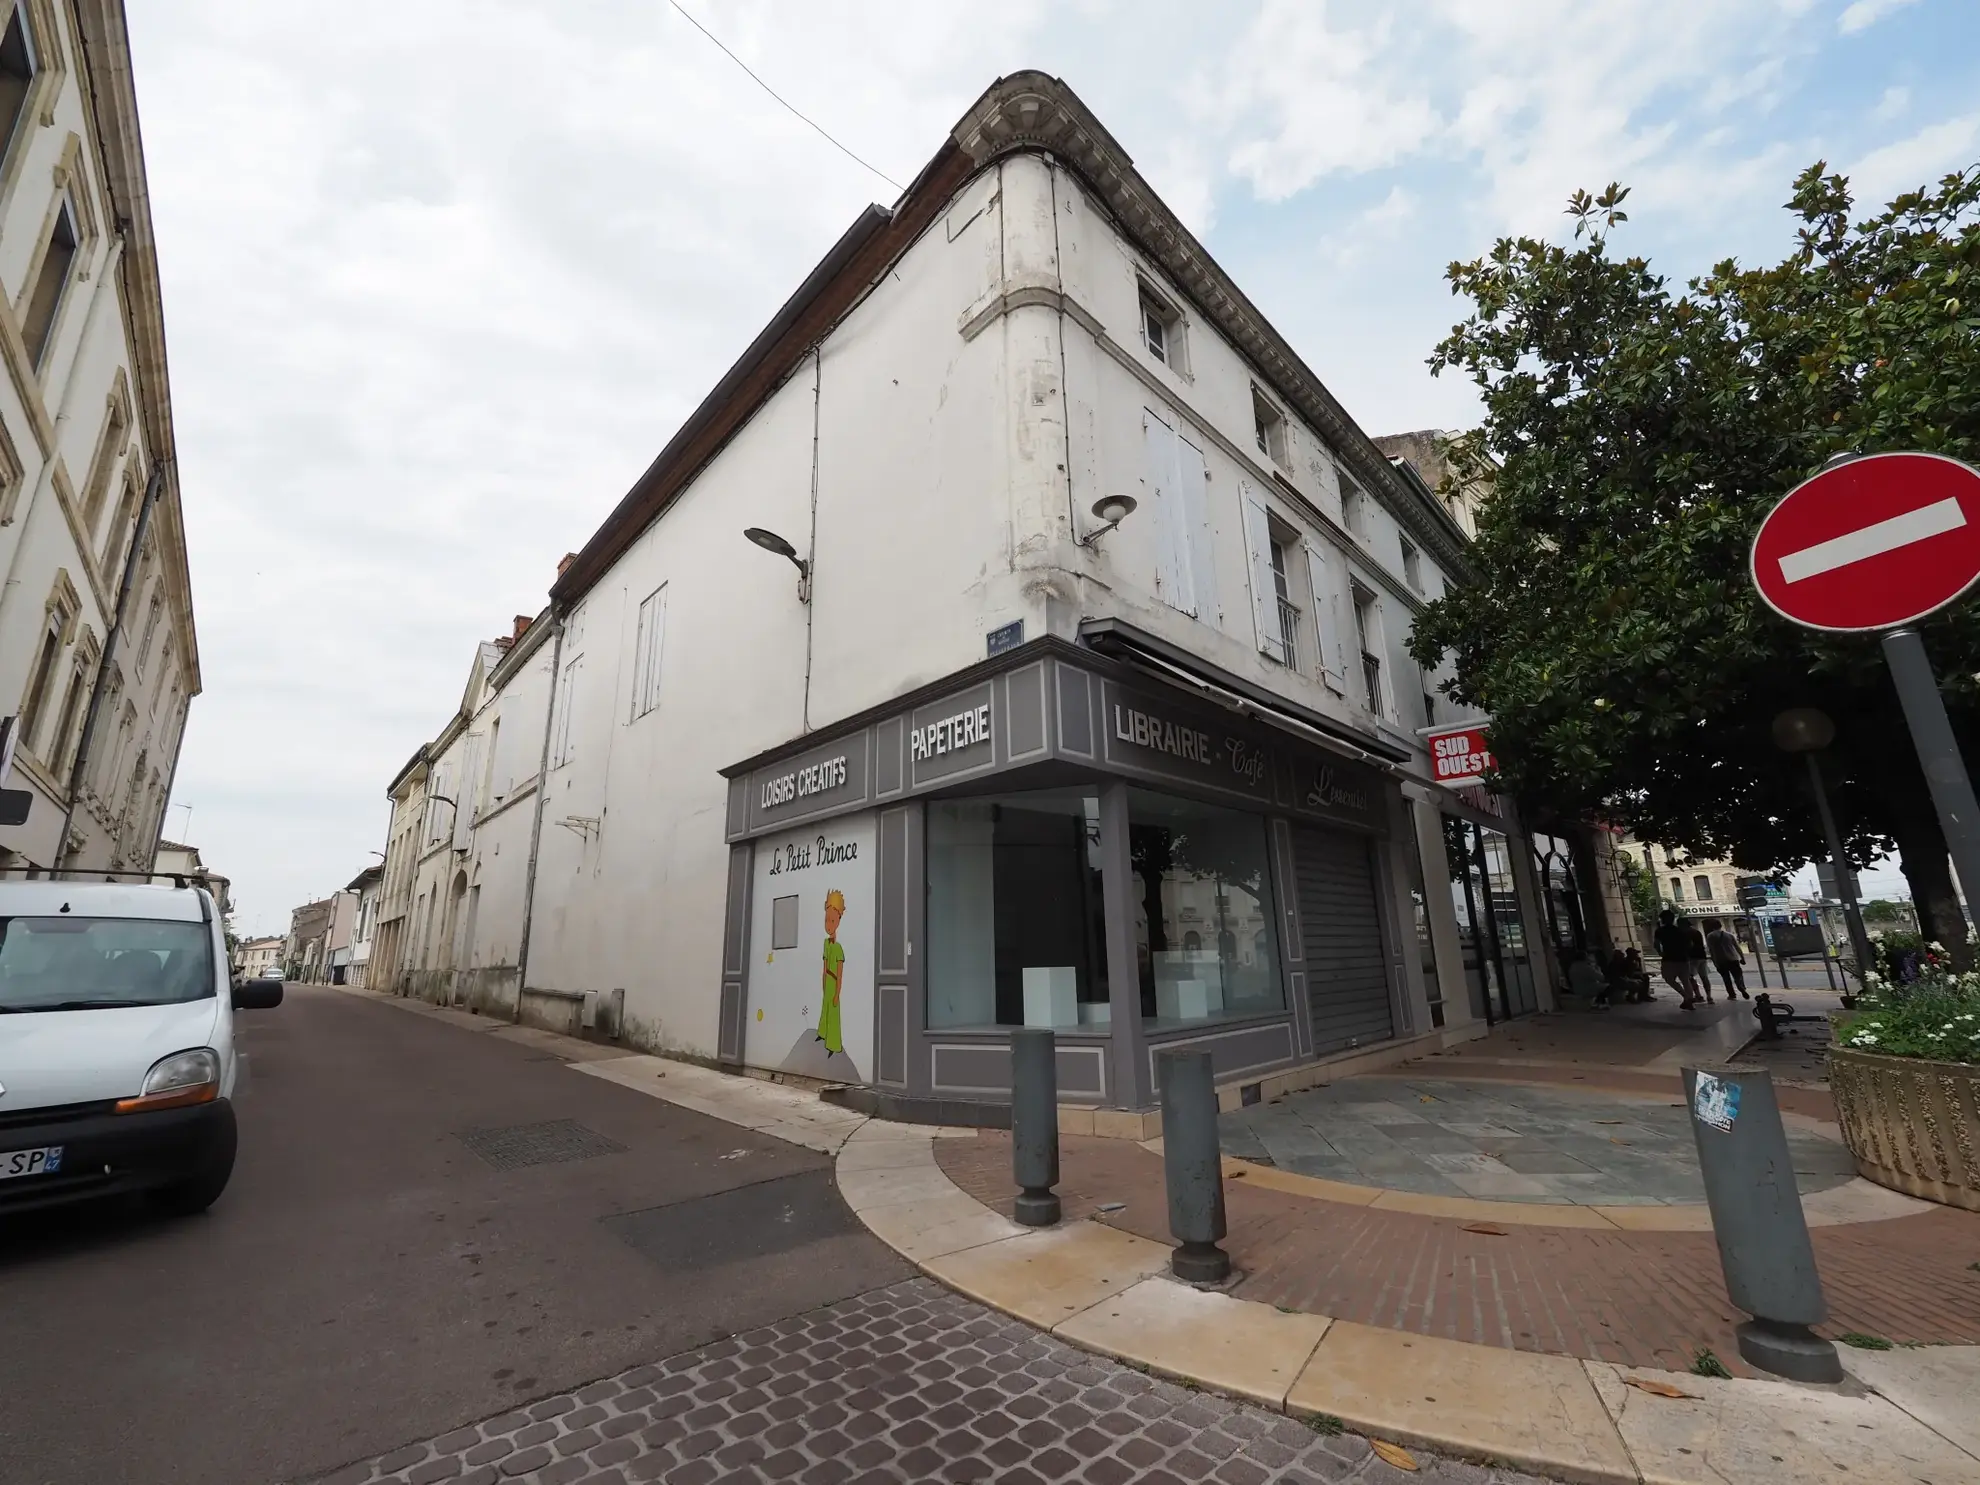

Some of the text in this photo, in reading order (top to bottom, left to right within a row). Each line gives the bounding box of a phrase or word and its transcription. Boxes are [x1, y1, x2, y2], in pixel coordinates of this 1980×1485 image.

[911, 703, 990, 762] PAPETERIE
[1115, 704, 1211, 765] LIBRAIRIE
[1224, 737, 1264, 786] Café
[1434, 736, 1470, 757] SUD
[761, 756, 846, 808] LOISIRS CREATIFS
[1437, 751, 1491, 776] OUEST
[770, 835, 857, 875] Le Petit Prince
